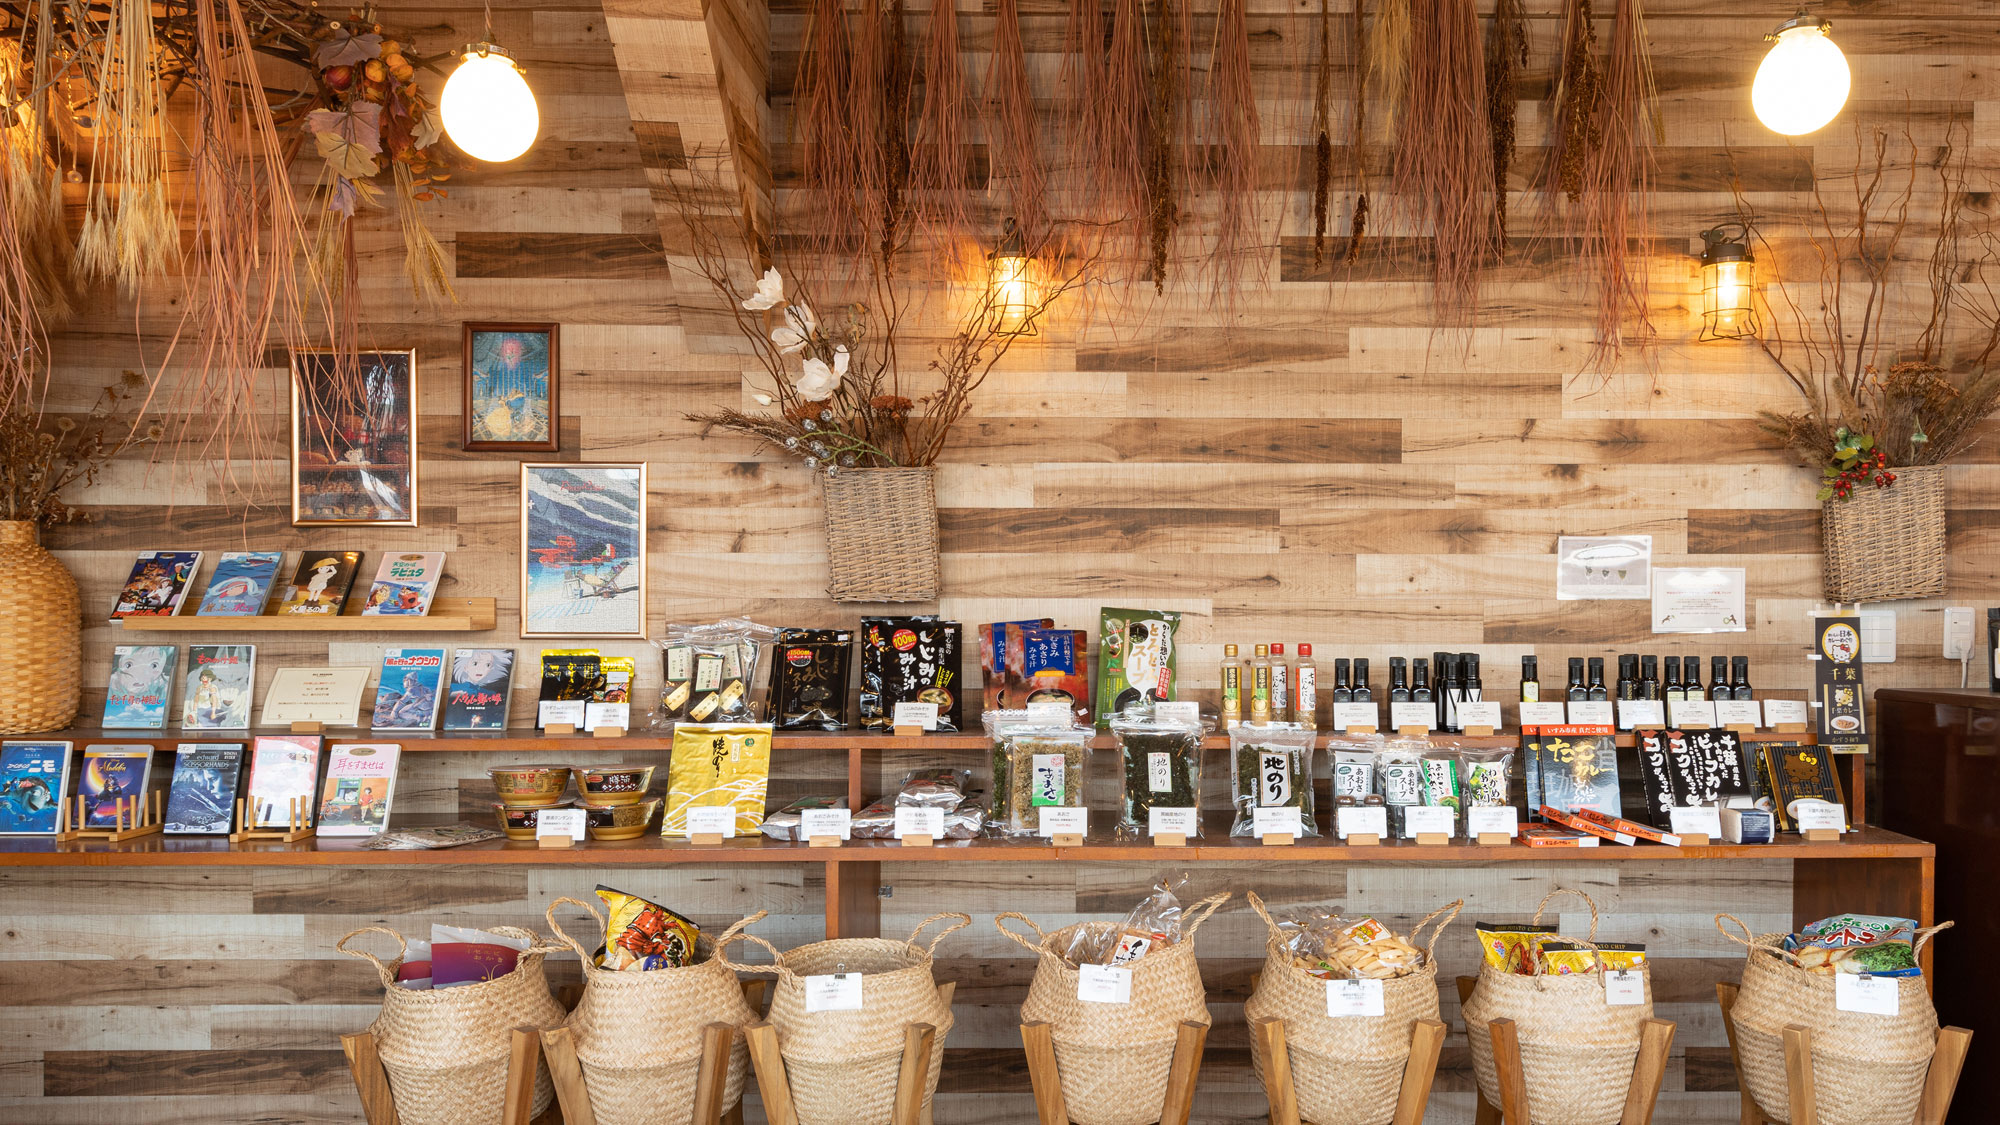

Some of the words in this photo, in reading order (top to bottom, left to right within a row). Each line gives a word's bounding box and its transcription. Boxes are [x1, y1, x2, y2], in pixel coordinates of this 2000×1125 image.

[390, 567, 425, 577] ラピュタ
[288, 604, 329, 614] 火垂るの墓
[1029, 646, 1038, 668] みそ汁
[1039, 643, 1048, 667] あさり
[1050, 635, 1060, 657] むきみ
[196, 653, 239, 665] もののけ姫
[385, 656, 440, 666] 風の谷のナウシカ
[802, 648, 830, 682] しじみ
[919, 630, 936, 685] しじみの
[1132, 645, 1147, 685] スープ
[898, 652, 918, 690] みそ汁
[1830, 667, 1856, 680] 千葉
[792, 672, 802, 693] スープ
[109, 694, 164, 706] 千と千尋の神隠し
[452, 692, 502, 706] ハウルの動く城
[1546, 737, 1596, 763] たこ
[28, 759, 56, 773] ニモ
[98, 760, 127, 772] Aladdin
[184, 760, 230, 768] SCISSORHANDS
[333, 757, 385, 773] 耳をすませば
[1156, 757, 1168, 787] 地のり
[1575, 761, 1615, 777] カレー
[1264, 756, 1286, 802] 地のり
[1347, 774, 1355, 796] スープ
[1356, 767, 1364, 792] あおさ
[1399, 777, 1408, 798] スープ
[1407, 769, 1415, 795] あおさ
[1481, 772, 1490, 803] あさり
[1489, 769, 1500, 798] わかめ
